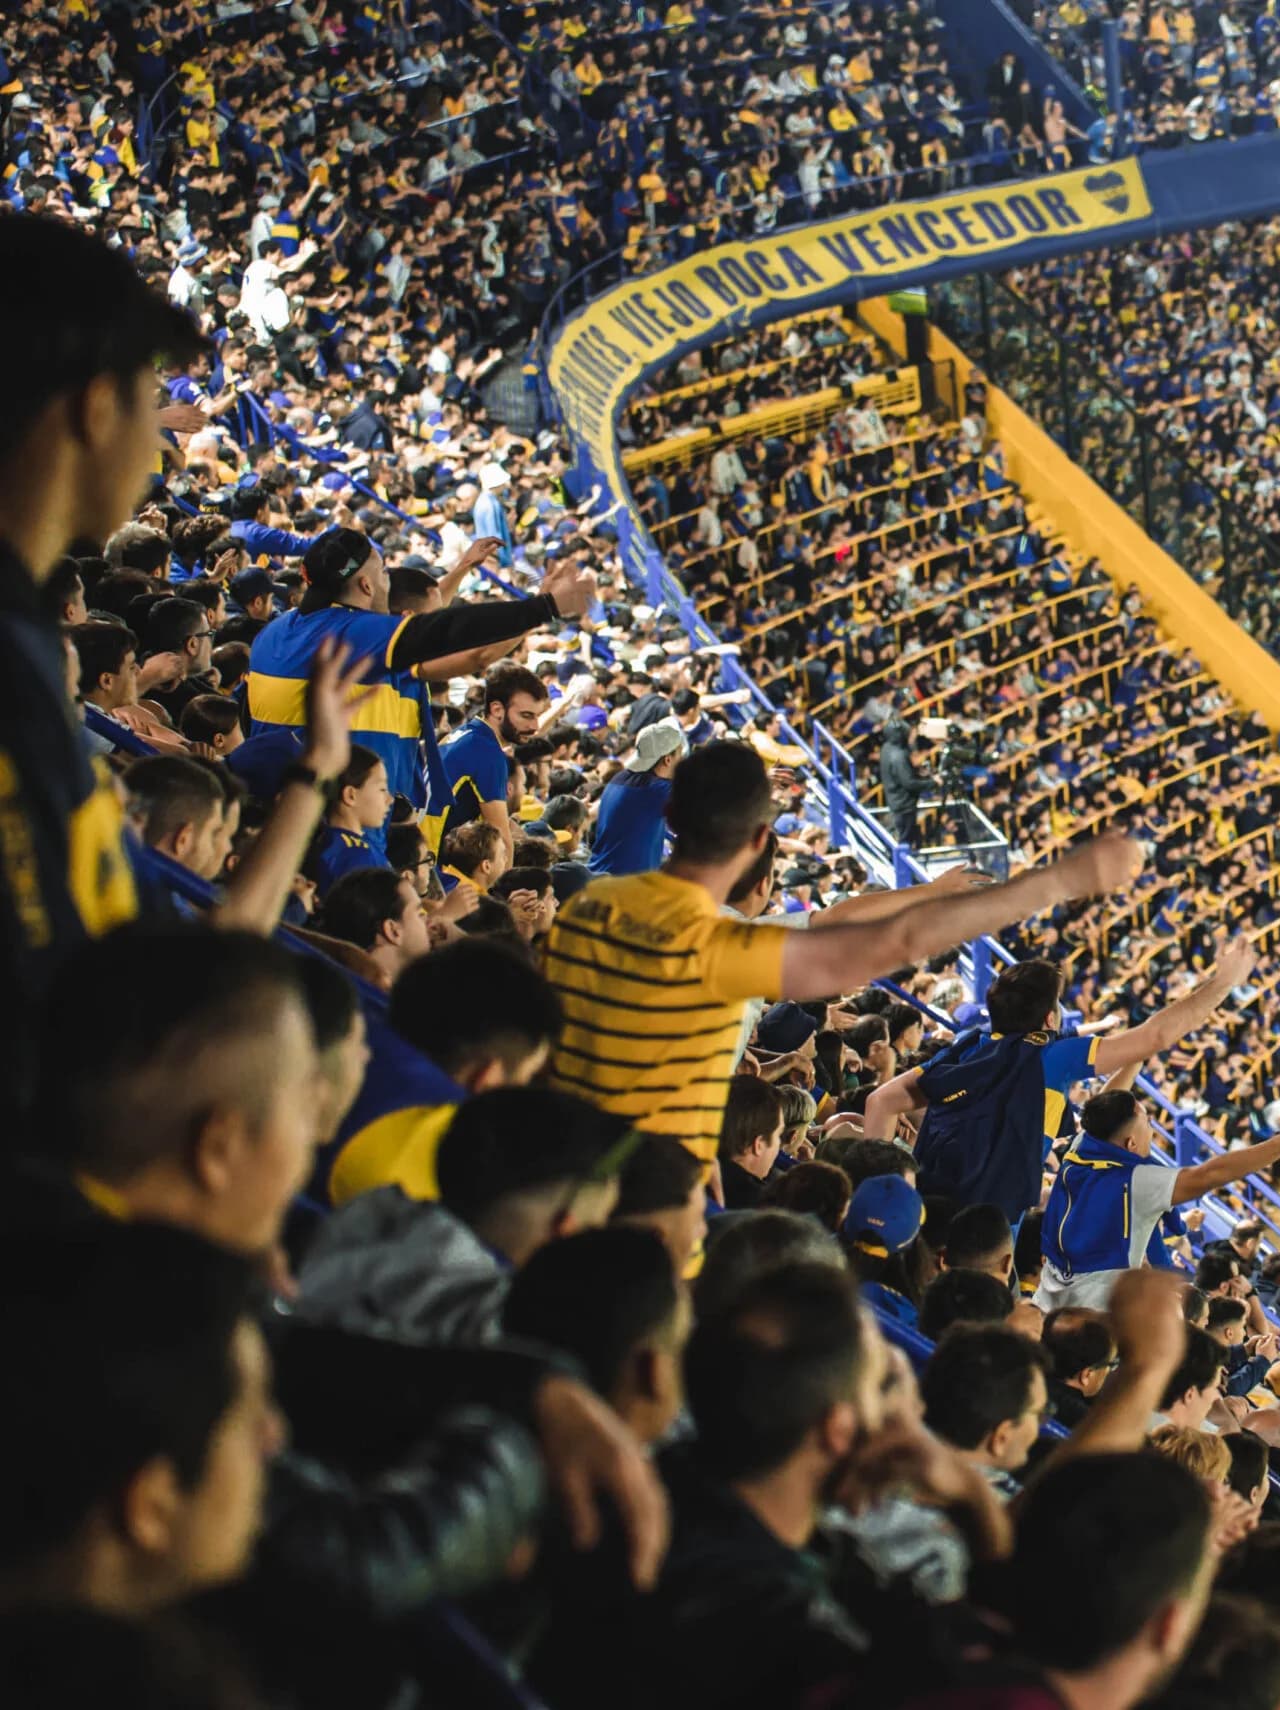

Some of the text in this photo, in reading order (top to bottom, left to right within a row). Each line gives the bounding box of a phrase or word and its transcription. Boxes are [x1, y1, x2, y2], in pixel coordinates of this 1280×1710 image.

[608, 279, 713, 348] VIEJO
[694, 245, 824, 307] BOCA
[817, 187, 1083, 273] VENCEDOR
